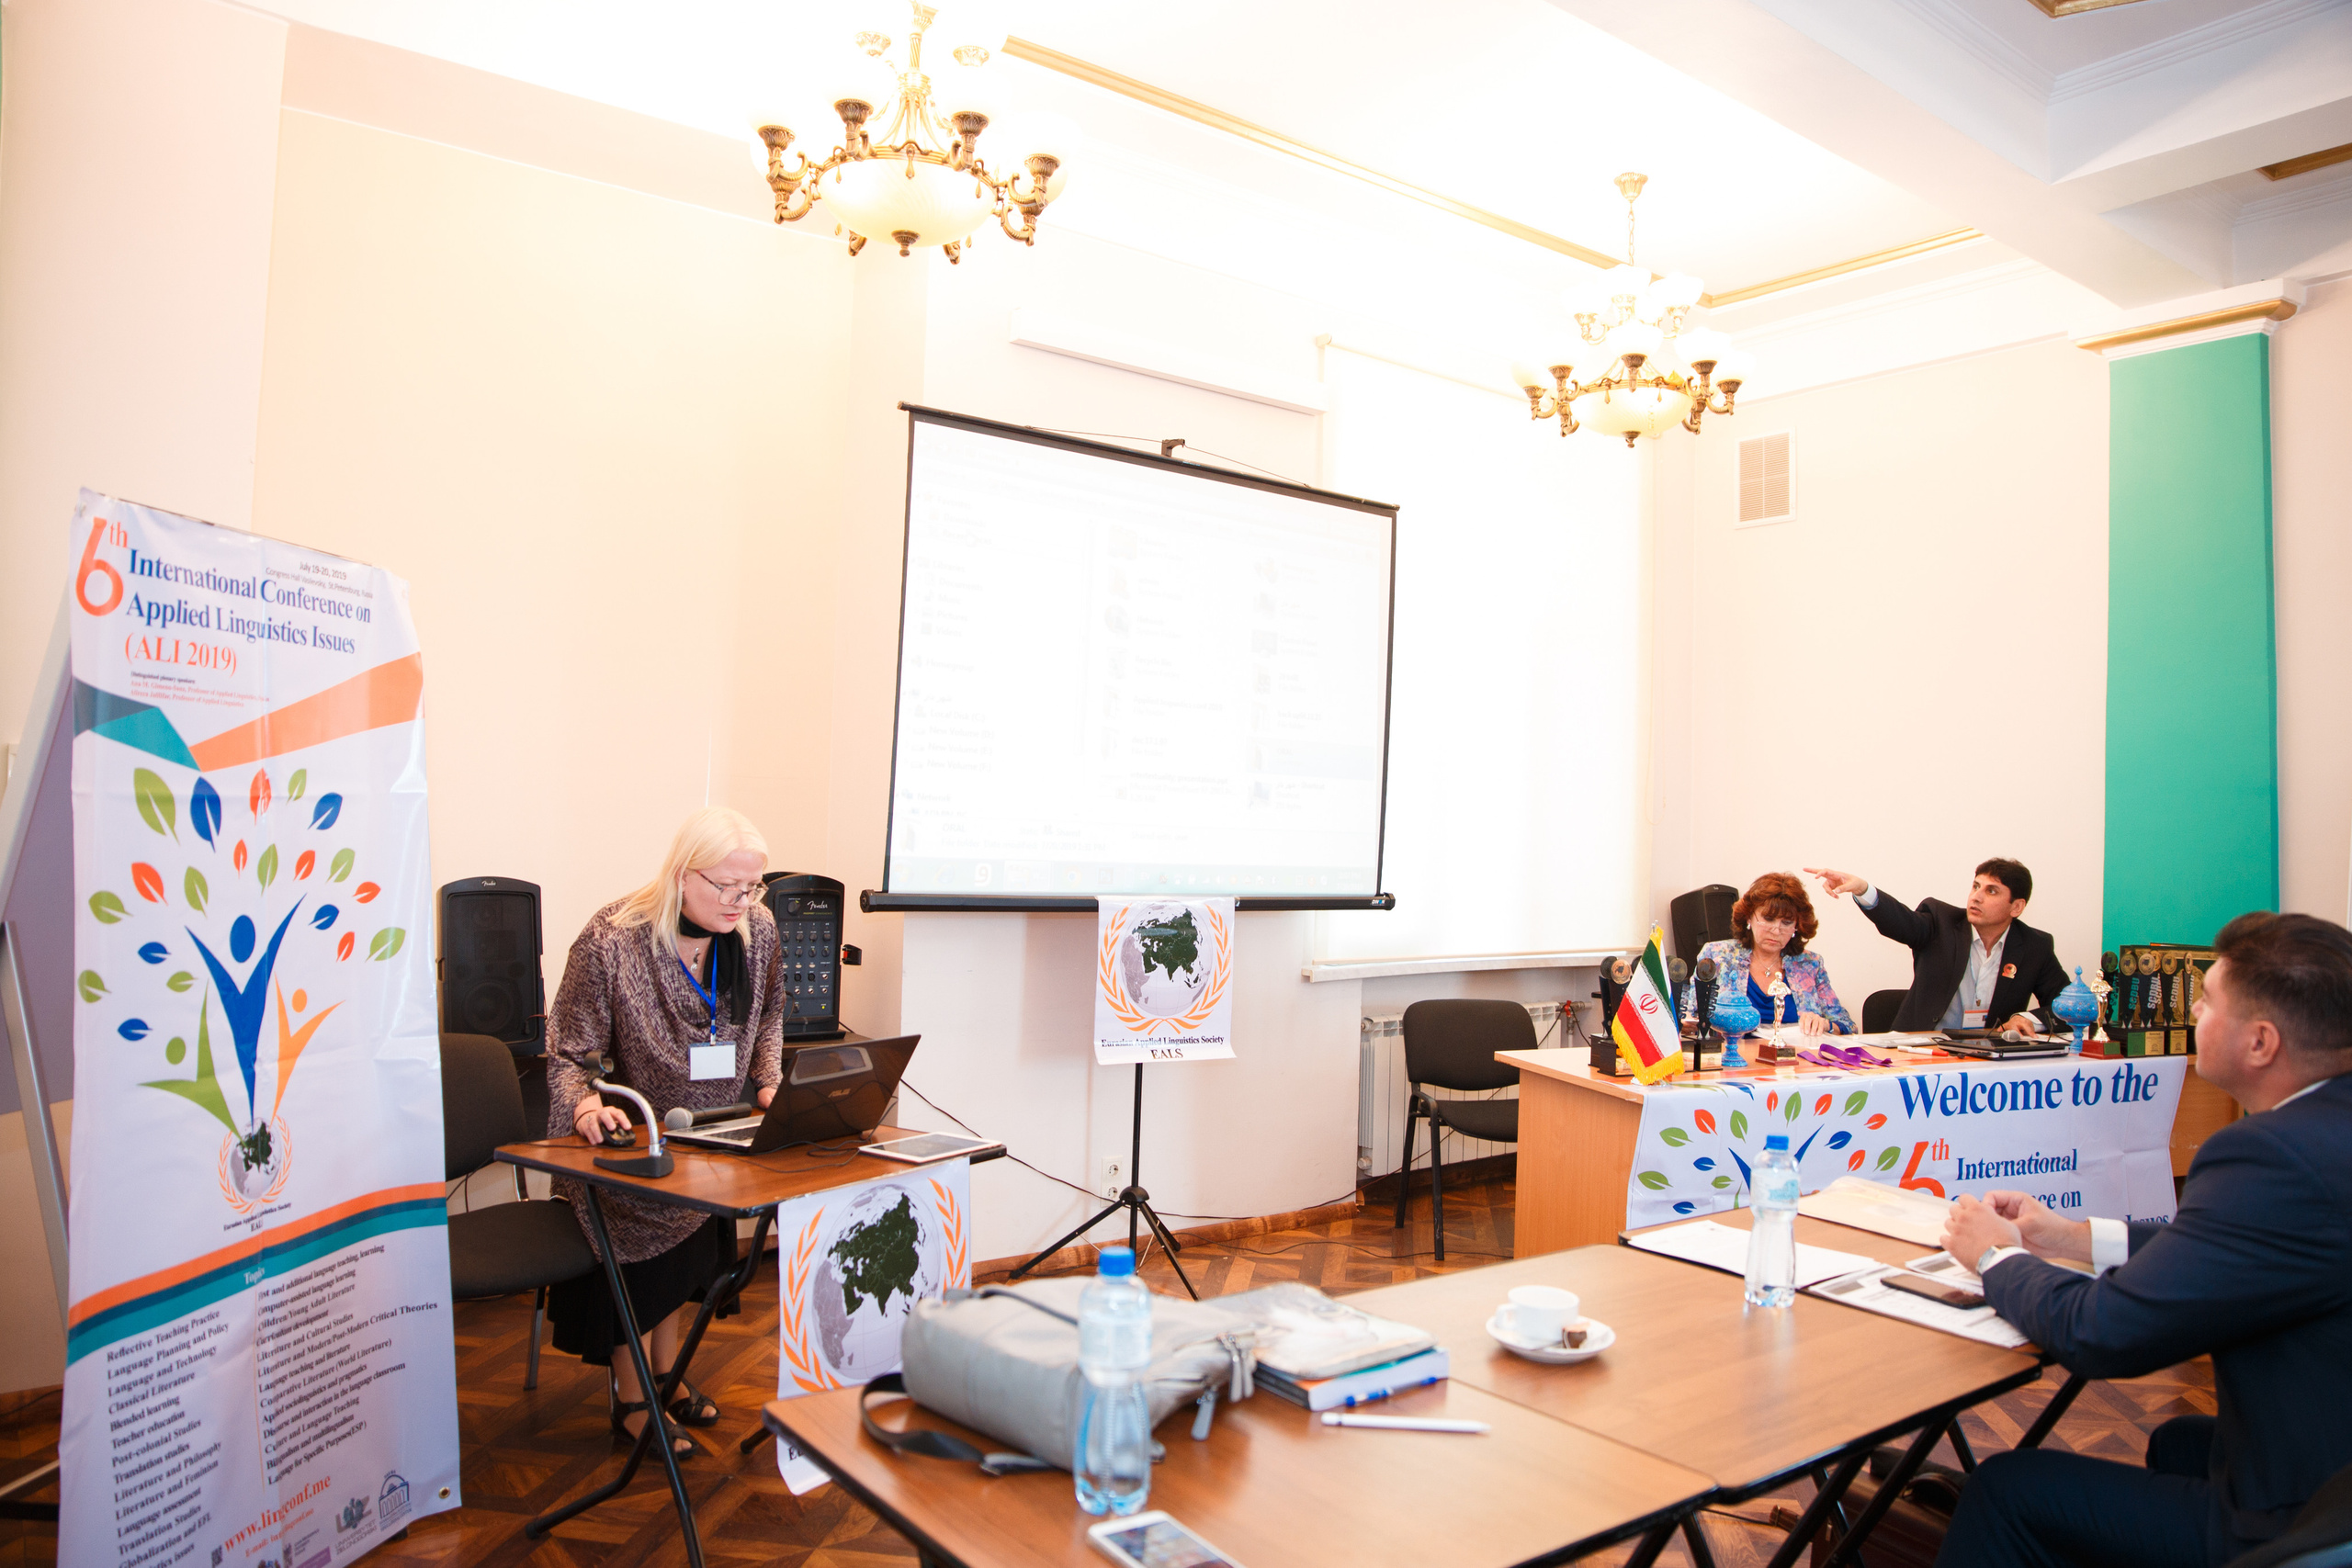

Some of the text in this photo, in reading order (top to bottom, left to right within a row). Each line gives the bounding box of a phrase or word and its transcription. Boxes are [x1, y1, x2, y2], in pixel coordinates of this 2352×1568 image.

[75, 516, 129, 616] 6 th
[129, 548, 371, 623] International Conference on
[126, 591, 356, 654] Applied Linguistics Issues
[125, 632, 237, 678] (ALI 2019)
[807, 900, 829, 910] Fender
[2128, 977, 2140, 1010] SCDBU
[2146, 976, 2159, 1010] SCDBU
[2169, 976, 2180, 1008] SCDBU
[1135, 1037, 1161, 1048] Applied
[1163, 1036, 1200, 1046] Linguistics
[1201, 1035, 1225, 1045] Society
[1150, 1048, 1183, 1059] EALS
[1895, 1063, 2159, 1120] Welcome to the
[1898, 1137, 1951, 1199] 6 th
[1955, 1148, 2078, 1180] International
[2060, 1190, 2082, 1208] on
[271, 1283, 285, 1296] and
[359, 1244, 385, 1258] learning
[335, 1269, 356, 1284] learning
[310, 1296, 326, 1310] Adult
[327, 1283, 356, 1302] Literature
[107, 1310, 220, 1362] Reflective Teaching Practice
[107, 1323, 229, 1380] Language Planning and Policy
[256, 1313, 354, 1363] Literature and Cultural Studies
[257, 1355, 291, 1378] Literature
[293, 1348, 306, 1361] and
[369, 1308, 398, 1325] Critical
[399, 1301, 438, 1315] Theories
[107, 1345, 217, 1397] Language and Technology
[260, 1337, 392, 1408] Coparative Literature (World Literature)
[288, 1362, 314, 1381] teaching
[314, 1355, 326, 1367] and
[326, 1343, 351, 1361] literature
[108, 1371, 195, 1415] Classical Literature
[110, 1395, 180, 1432] Blended learning
[262, 1406, 285, 1425] Apied
[327, 1377, 338, 1389] and
[338, 1363, 368, 1384] pragmatics
[290, 1411, 302, 1424] and
[302, 1397, 333, 1417] interaction
[340, 1386, 349, 1398] the
[373, 1362, 406, 1380] classroom
[111, 1410, 186, 1450] Teacher education
[288, 1426, 301, 1439] and
[302, 1411, 333, 1432] Language
[333, 1395, 360, 1416] Teaching
[111, 1419, 201, 1468] Post-colonial Studies
[114, 1442, 190, 1484] Translation studies
[266, 1445, 300, 1470] Bilgualism
[300, 1437, 312, 1450] and
[114, 1441, 221, 1503] Literature and Philosophy
[115, 1460, 219, 1520] Literature and Feminism
[267, 1464, 294, 1486] Laguage
[117, 1486, 201, 1539] Language assessment
[119, 1504, 201, 1556] Translation Studies
[184, 1522, 197, 1538] and
